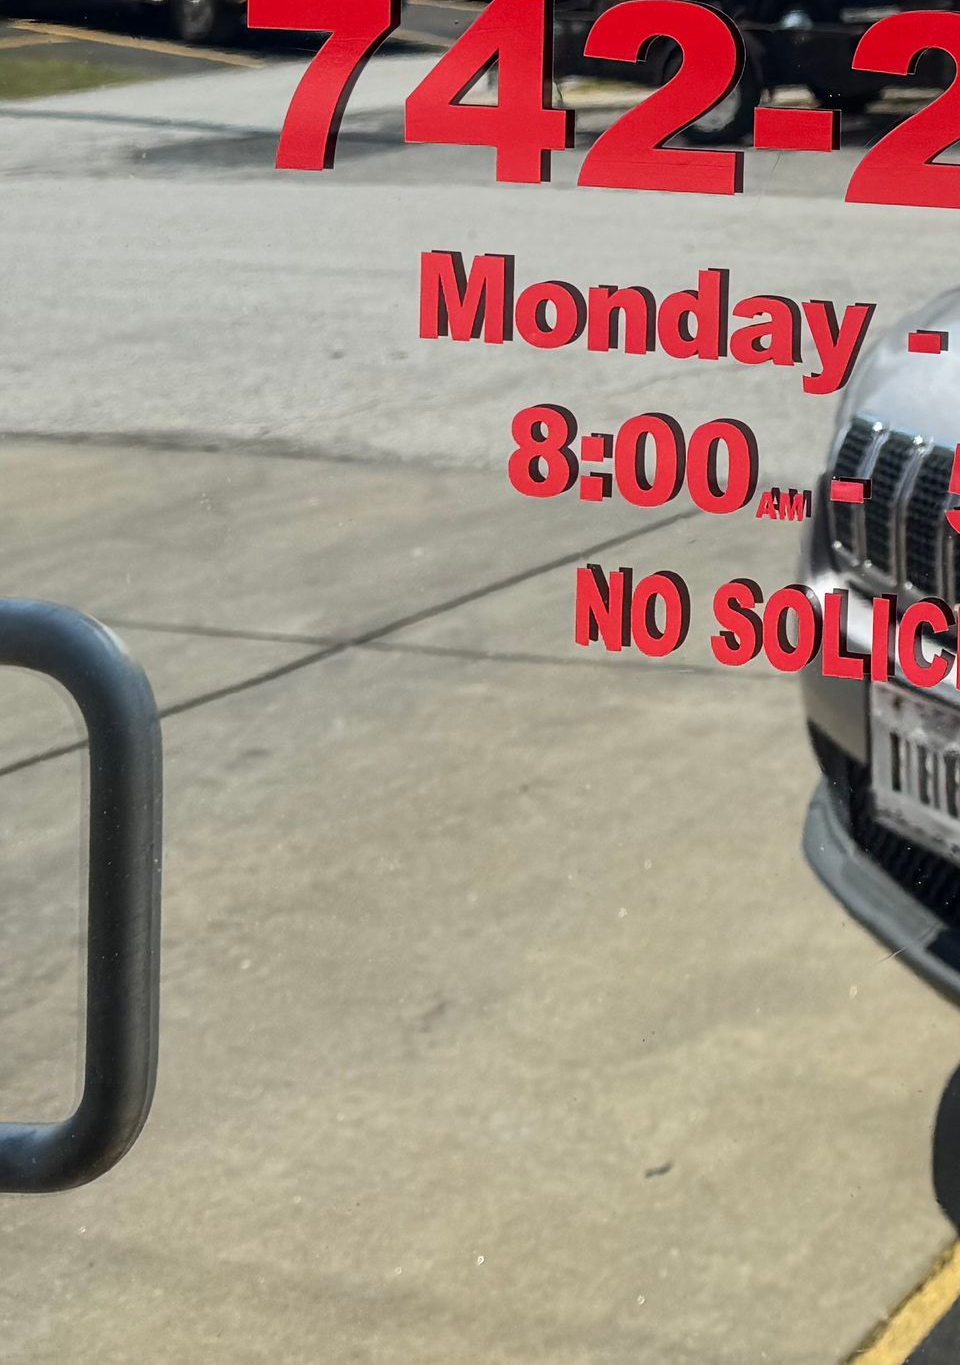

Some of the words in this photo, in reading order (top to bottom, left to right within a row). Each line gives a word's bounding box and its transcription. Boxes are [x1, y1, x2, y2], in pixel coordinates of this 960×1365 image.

[419, 251, 873, 395] Monday
[508, 405, 756, 514] 8:00
[756, 489, 811, 522] AM
[575, 565, 689, 658] NO
